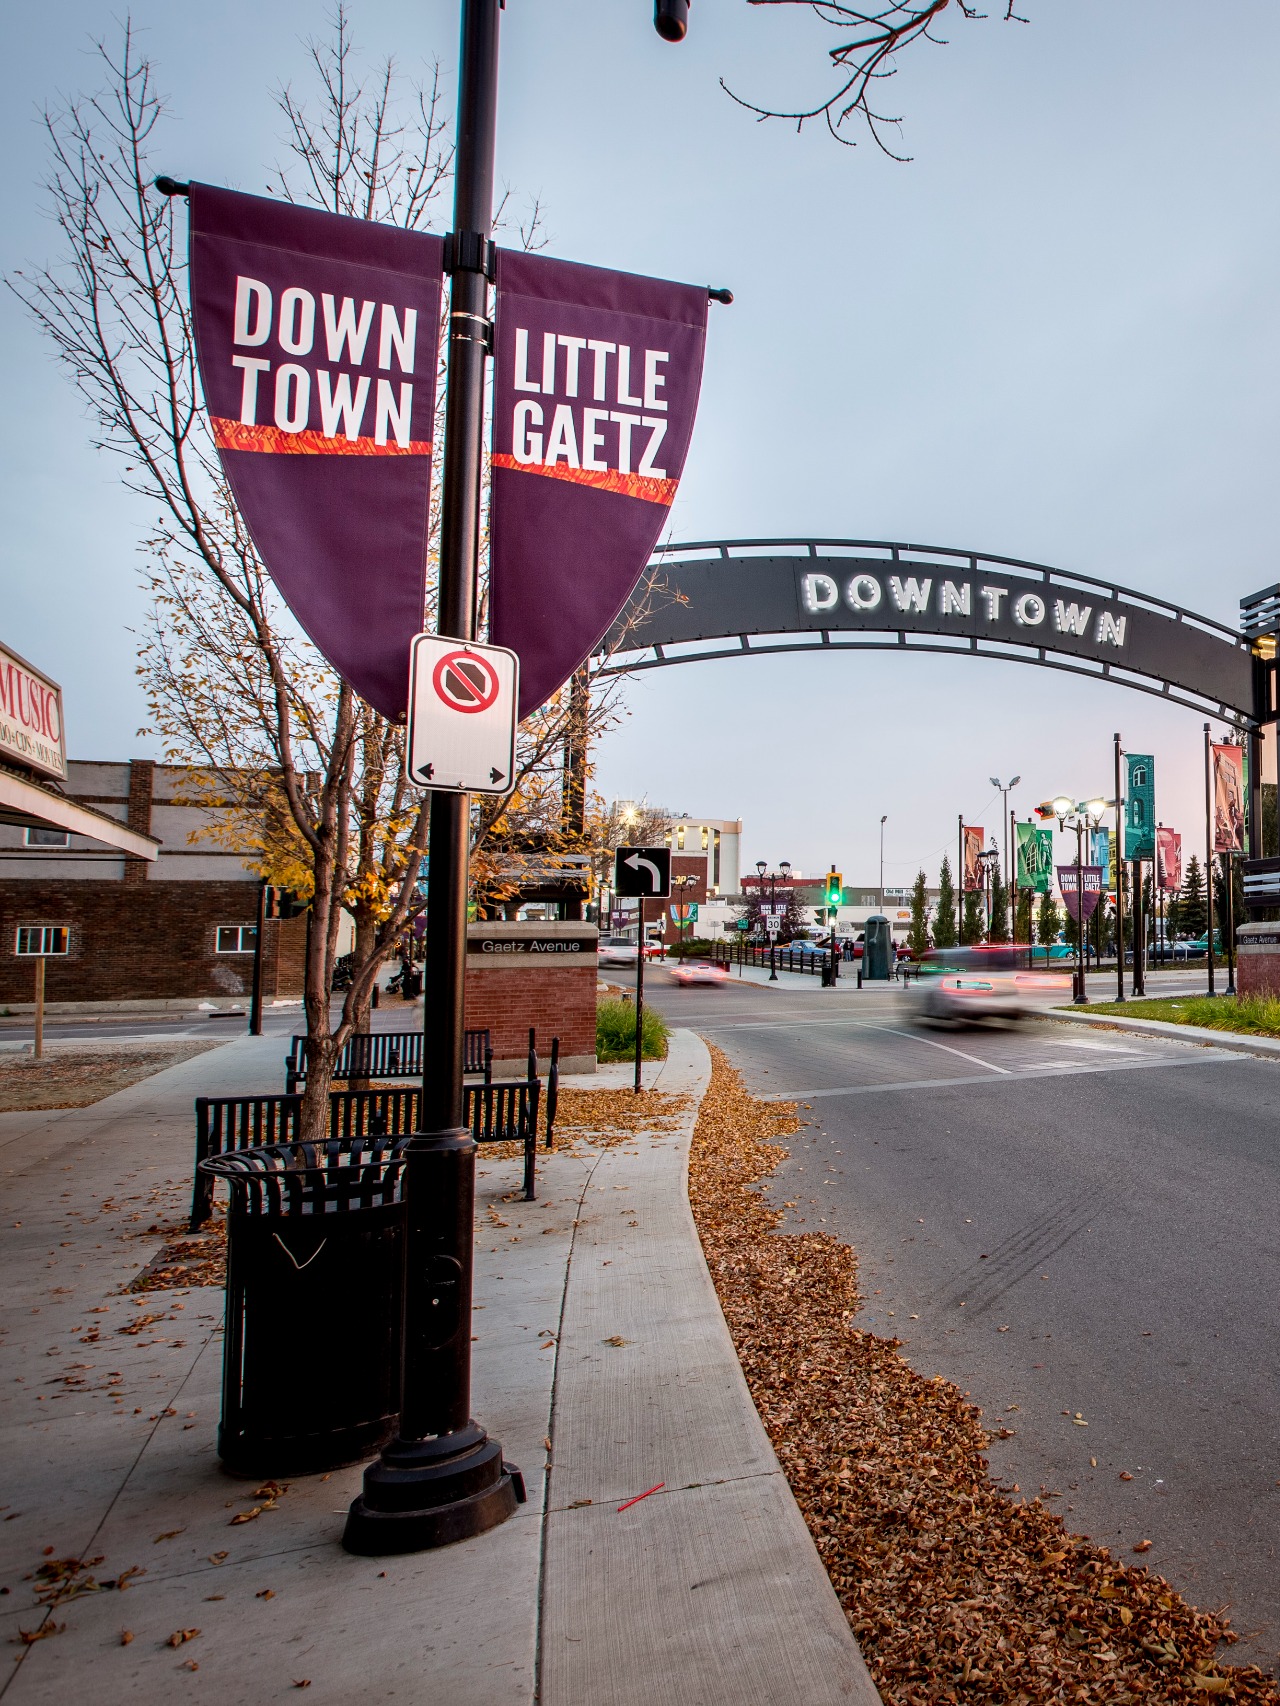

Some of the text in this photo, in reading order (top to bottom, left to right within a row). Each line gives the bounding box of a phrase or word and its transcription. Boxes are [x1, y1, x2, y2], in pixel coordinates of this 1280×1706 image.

[233, 275, 418, 374] DOWN
[514, 327, 670, 411] LITTLE
[231, 354, 414, 449] TOWN
[512, 399, 668, 480] GAETZ
[804, 573, 1127, 647] DOWNTOWN
[0, 661, 60, 743] MUSIC
[1060, 873, 1077, 883] DOWN
[1084, 874, 1100, 882] LITTLE
[1061, 882, 1077, 891] TOWN
[1084, 882, 1100, 891] GAETZ
[768, 920, 780, 929] 30
[482, 940, 580, 953] Gaetz Avenue
[1243, 935, 1278, 945] Gaetz Avenue
